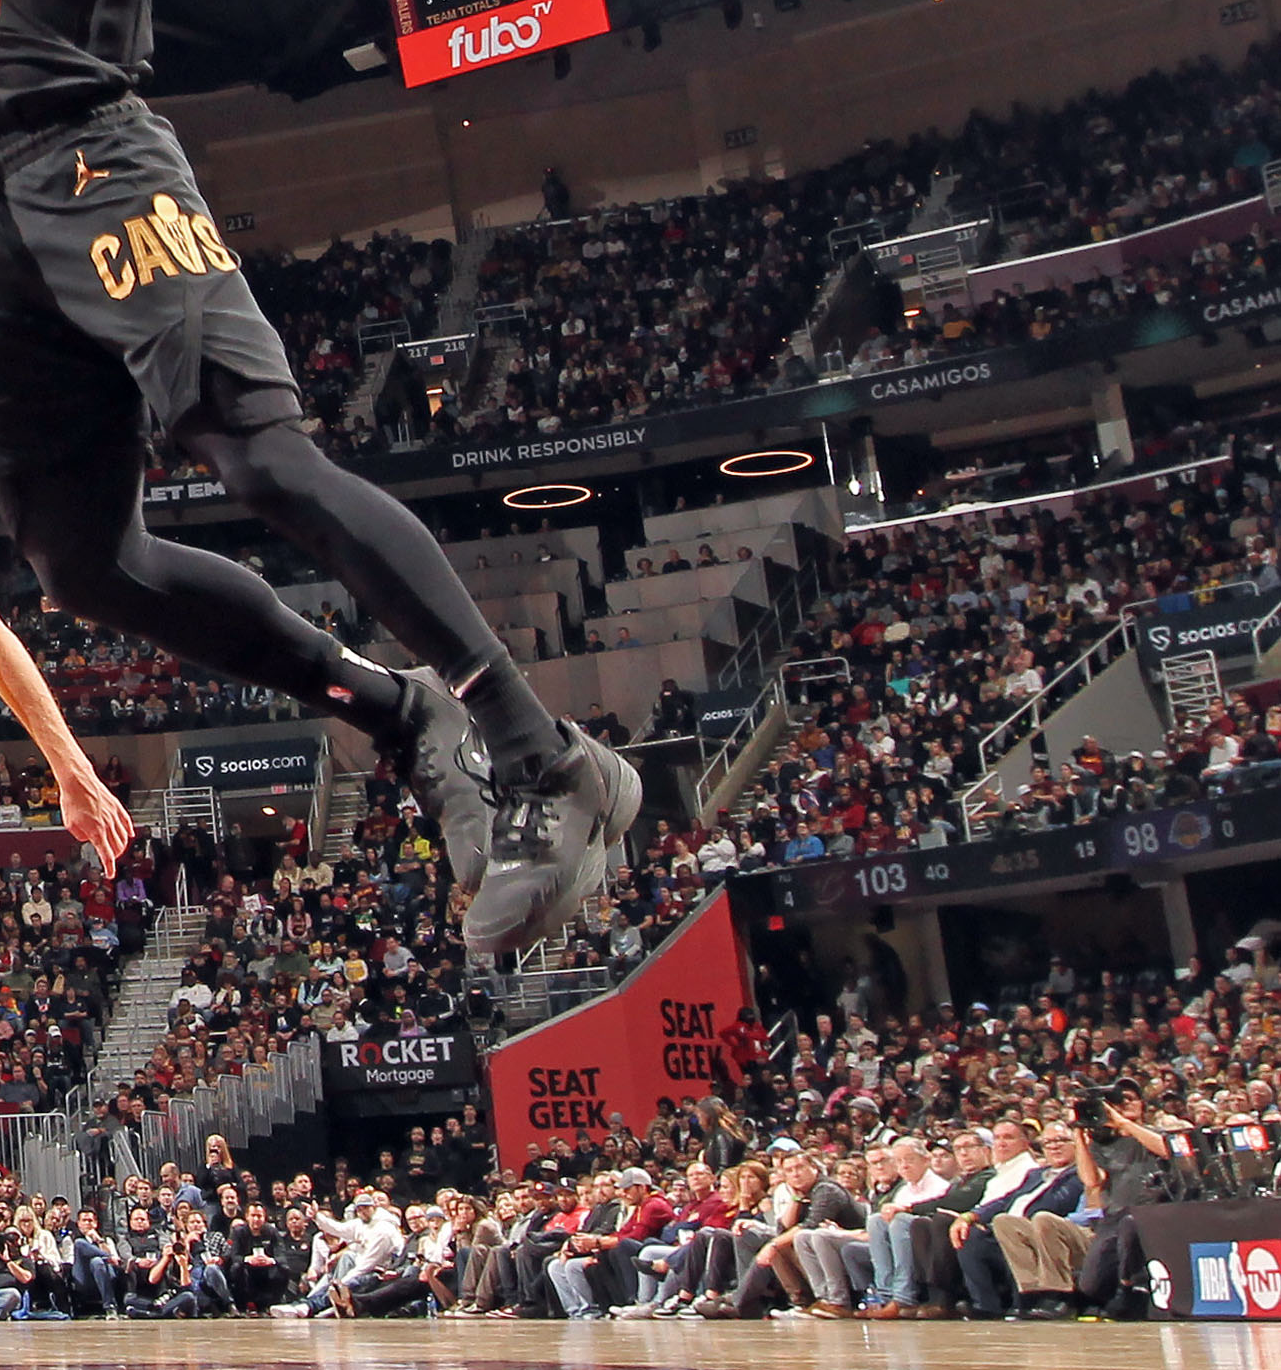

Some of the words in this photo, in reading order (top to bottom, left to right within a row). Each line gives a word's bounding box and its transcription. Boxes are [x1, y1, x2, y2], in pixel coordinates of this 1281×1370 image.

[426, 10, 457, 26] TEAM
[448, 15, 541, 68] fubo
[532, 0, 553, 18] TV
[91, 192, 238, 300] CAVS
[877, 246, 899, 259] 218
[408, 347, 430, 358] 217
[445, 341, 466, 352] 218
[871, 362, 990, 400] CASAMIGOS
[452, 448, 511, 468] DRINK
[518, 428, 645, 459] RESPONSIBLY
[188, 482, 226, 498] EM
[220, 755, 307, 773] SOCIOS.com
[1124, 824, 1160, 856] 98
[1221, 822, 1234, 838] 0
[1075, 842, 1096, 858] 15
[855, 863, 907, 897] 103
[925, 865, 949, 880] 4Q
[784, 890, 795, 908] 4
[660, 998, 715, 1039] SEAT
[341, 1037, 454, 1067] ROCKET
[664, 1043, 722, 1080] GEEK
[366, 1069, 434, 1084] Mortgage
[528, 1067, 600, 1097] SEAT
[528, 1100, 610, 1129] GEEK
[1198, 1257, 1230, 1301] NBA
[1247, 1272, 1281, 1294] TNT
